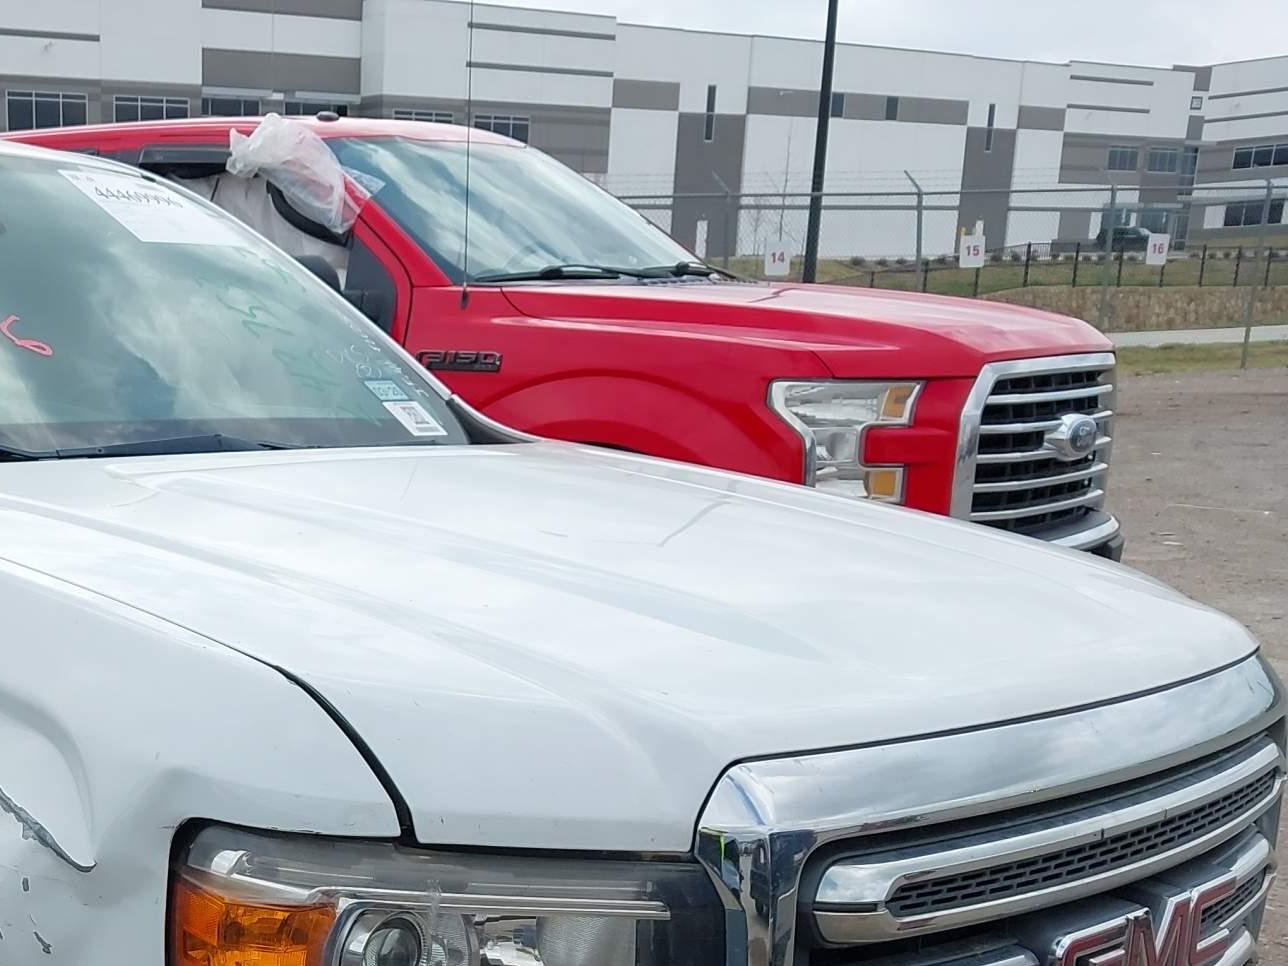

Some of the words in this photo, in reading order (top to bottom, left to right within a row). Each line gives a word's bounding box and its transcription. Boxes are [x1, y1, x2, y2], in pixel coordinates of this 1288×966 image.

[966, 245, 980, 256] 15
[1153, 243, 1165, 254] 16
[771, 251, 785, 264] 14
